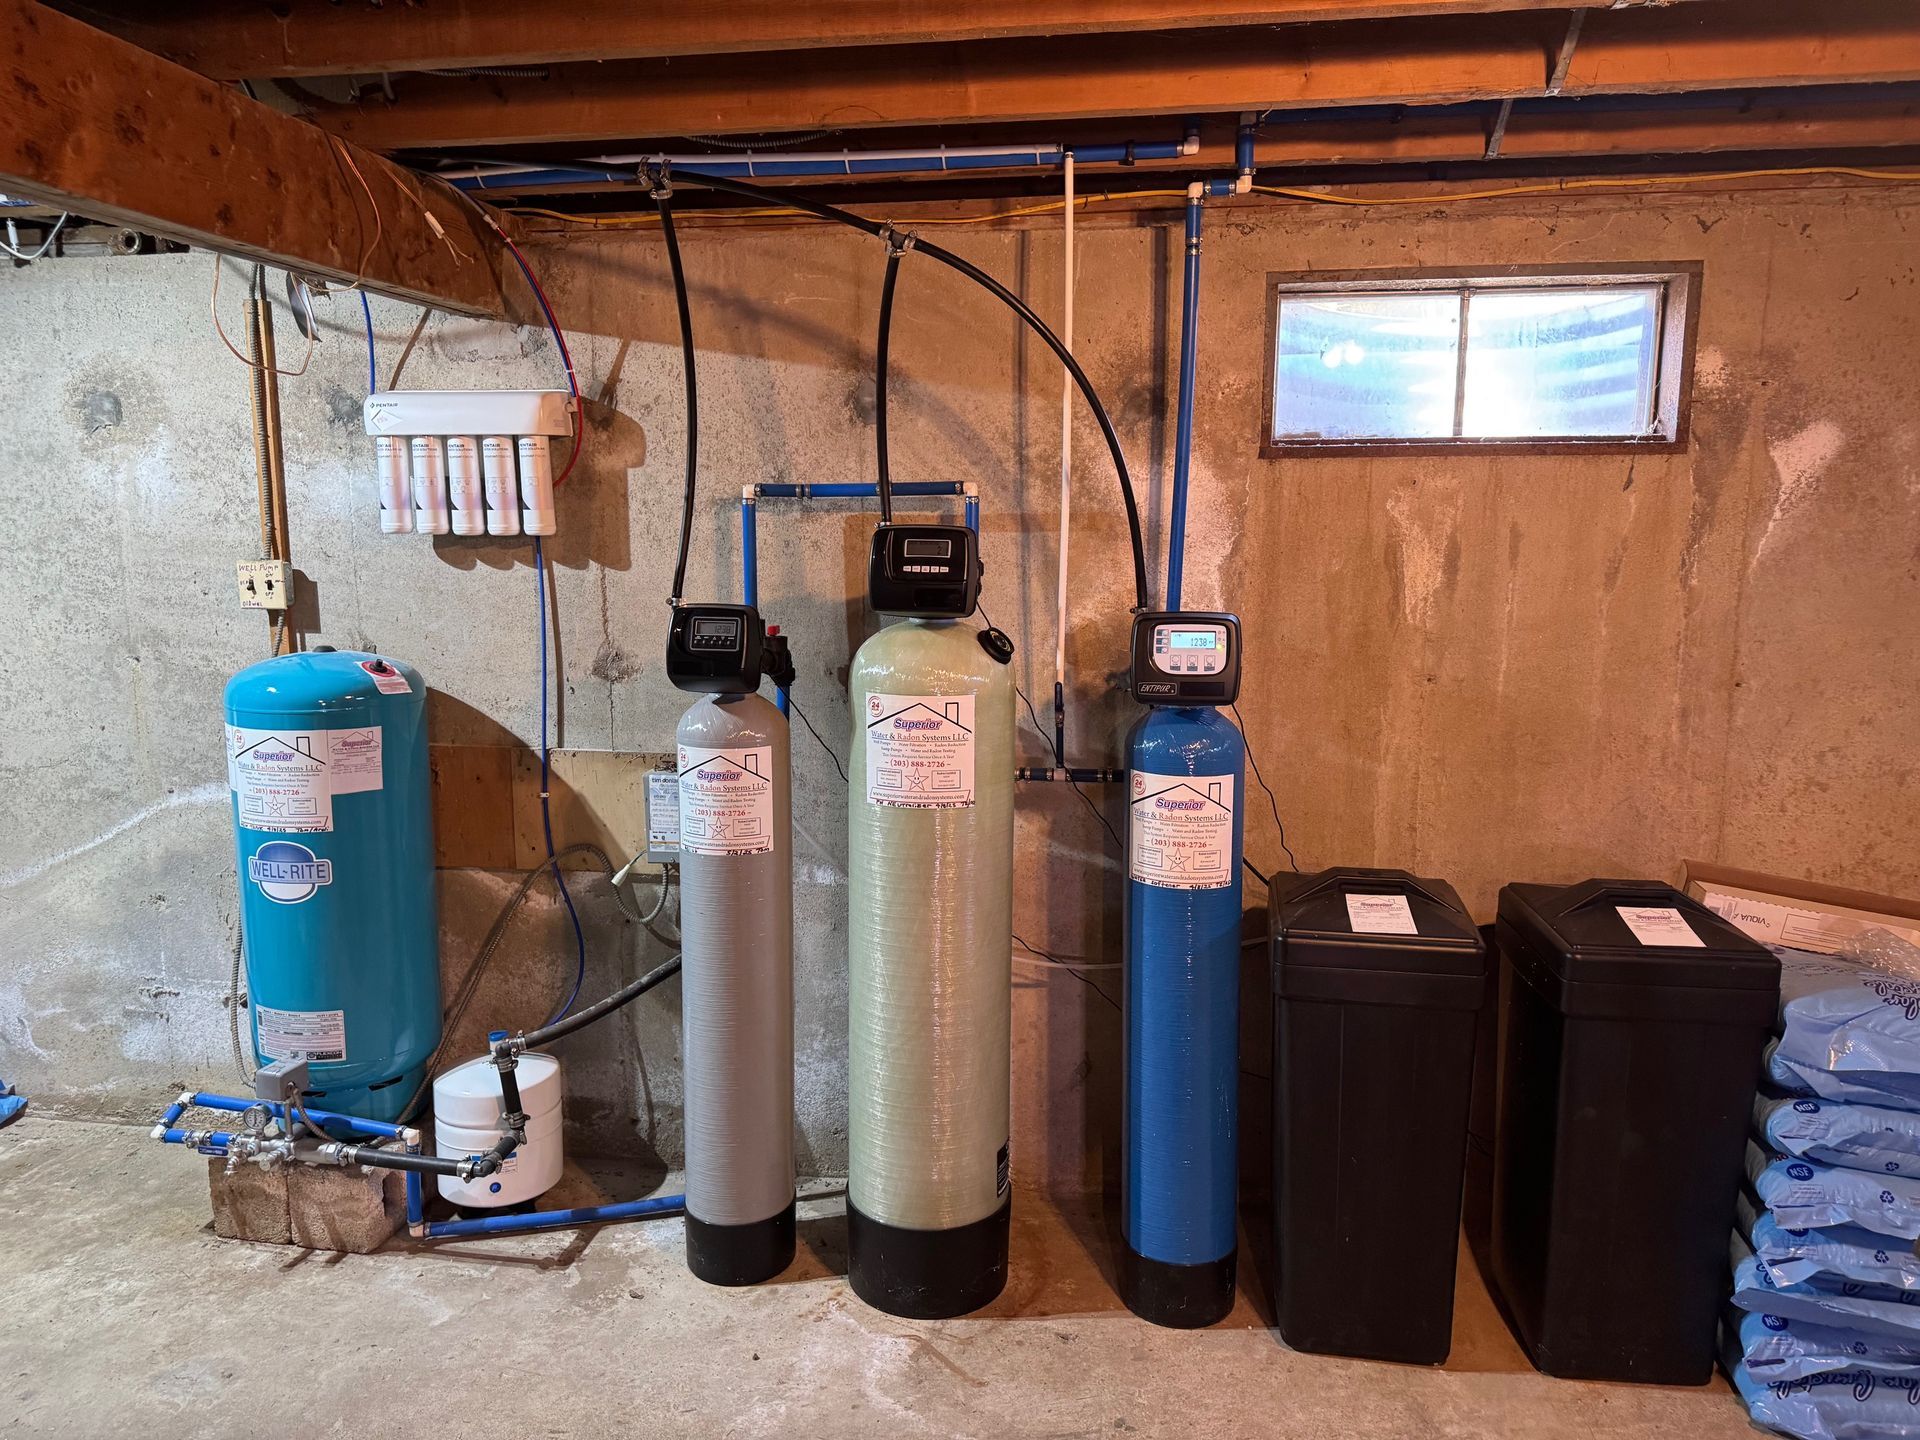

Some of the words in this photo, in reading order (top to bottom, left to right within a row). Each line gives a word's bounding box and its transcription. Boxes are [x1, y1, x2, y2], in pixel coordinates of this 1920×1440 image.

[894, 717, 943, 732] Superior
[871, 730, 888, 739] Water
[897, 732, 920, 740] Radon
[922, 733, 951, 742] Systems
[952, 733, 969, 741] LLC
[253, 750, 295, 762] Superior
[890, 759, 909, 767] (203)
[277, 765, 304, 773] Systems
[697, 769, 742, 783] Superior
[253, 787, 268, 795] (203)
[722, 784, 751, 792] Systems
[752, 782, 767, 790] LLC
[1155, 797, 1206, 812] Superior
[694, 808, 712, 817] (203)
[1134, 807, 1150, 817] Water
[1151, 811, 1157, 819] &
[1159, 812, 1182, 821] Radon
[1184, 813, 1213, 823] Systems
[1214, 812, 1229, 821] LLC
[1151, 838, 1170, 848] (203)
[1741, 914, 1766, 924] VIQUA
[1795, 1103, 1815, 1112] NSF
[1789, 1167, 1809, 1177] NSF
